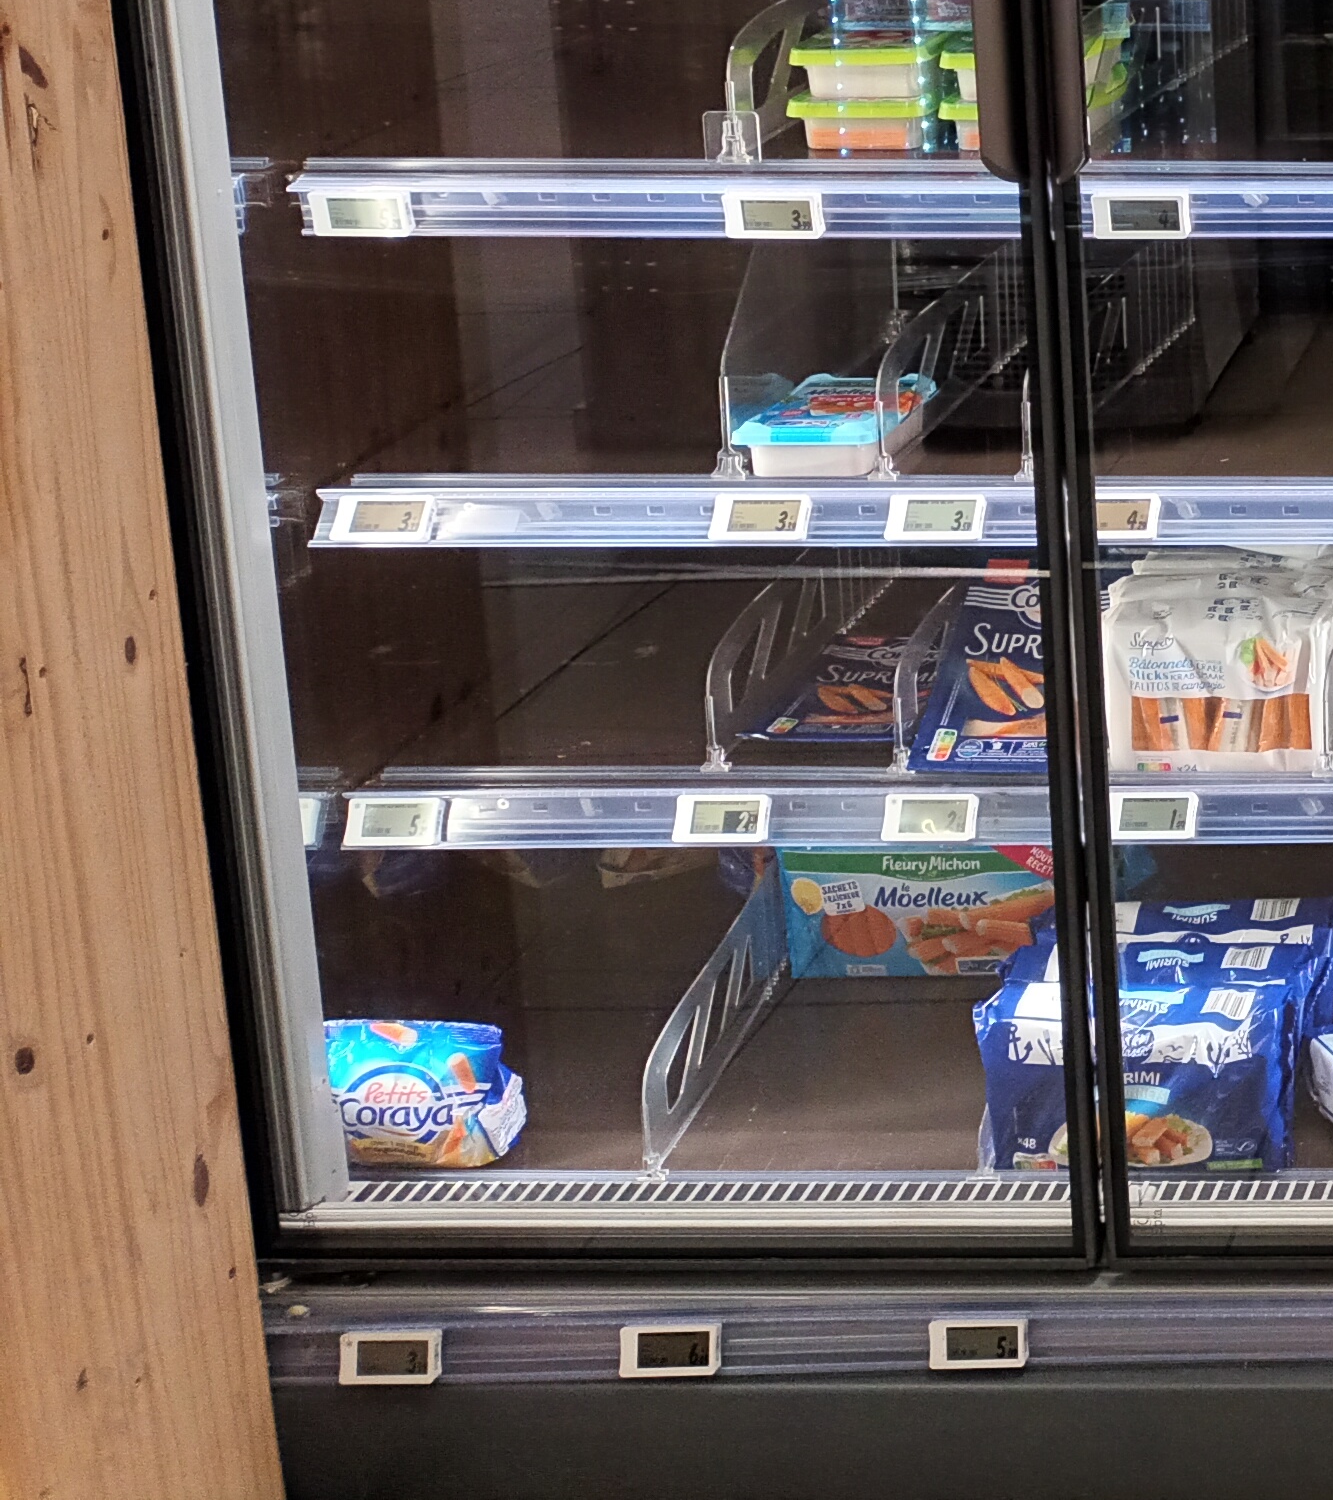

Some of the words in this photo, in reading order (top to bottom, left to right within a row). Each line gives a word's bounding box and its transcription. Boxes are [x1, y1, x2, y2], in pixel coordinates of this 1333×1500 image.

[1129, 669, 1170, 681] Sticks
[1129, 680, 1170, 691] PALITOS
[882, 855, 928, 875] Fleury
[928, 854, 981, 871] Michon
[821, 880, 858, 895] SACHETS
[873, 886, 989, 909] Moelleux
[364, 1082, 429, 1105] Petits
[340, 1097, 454, 1132] Coraya
[1016, 1137, 1037, 1151] x48
